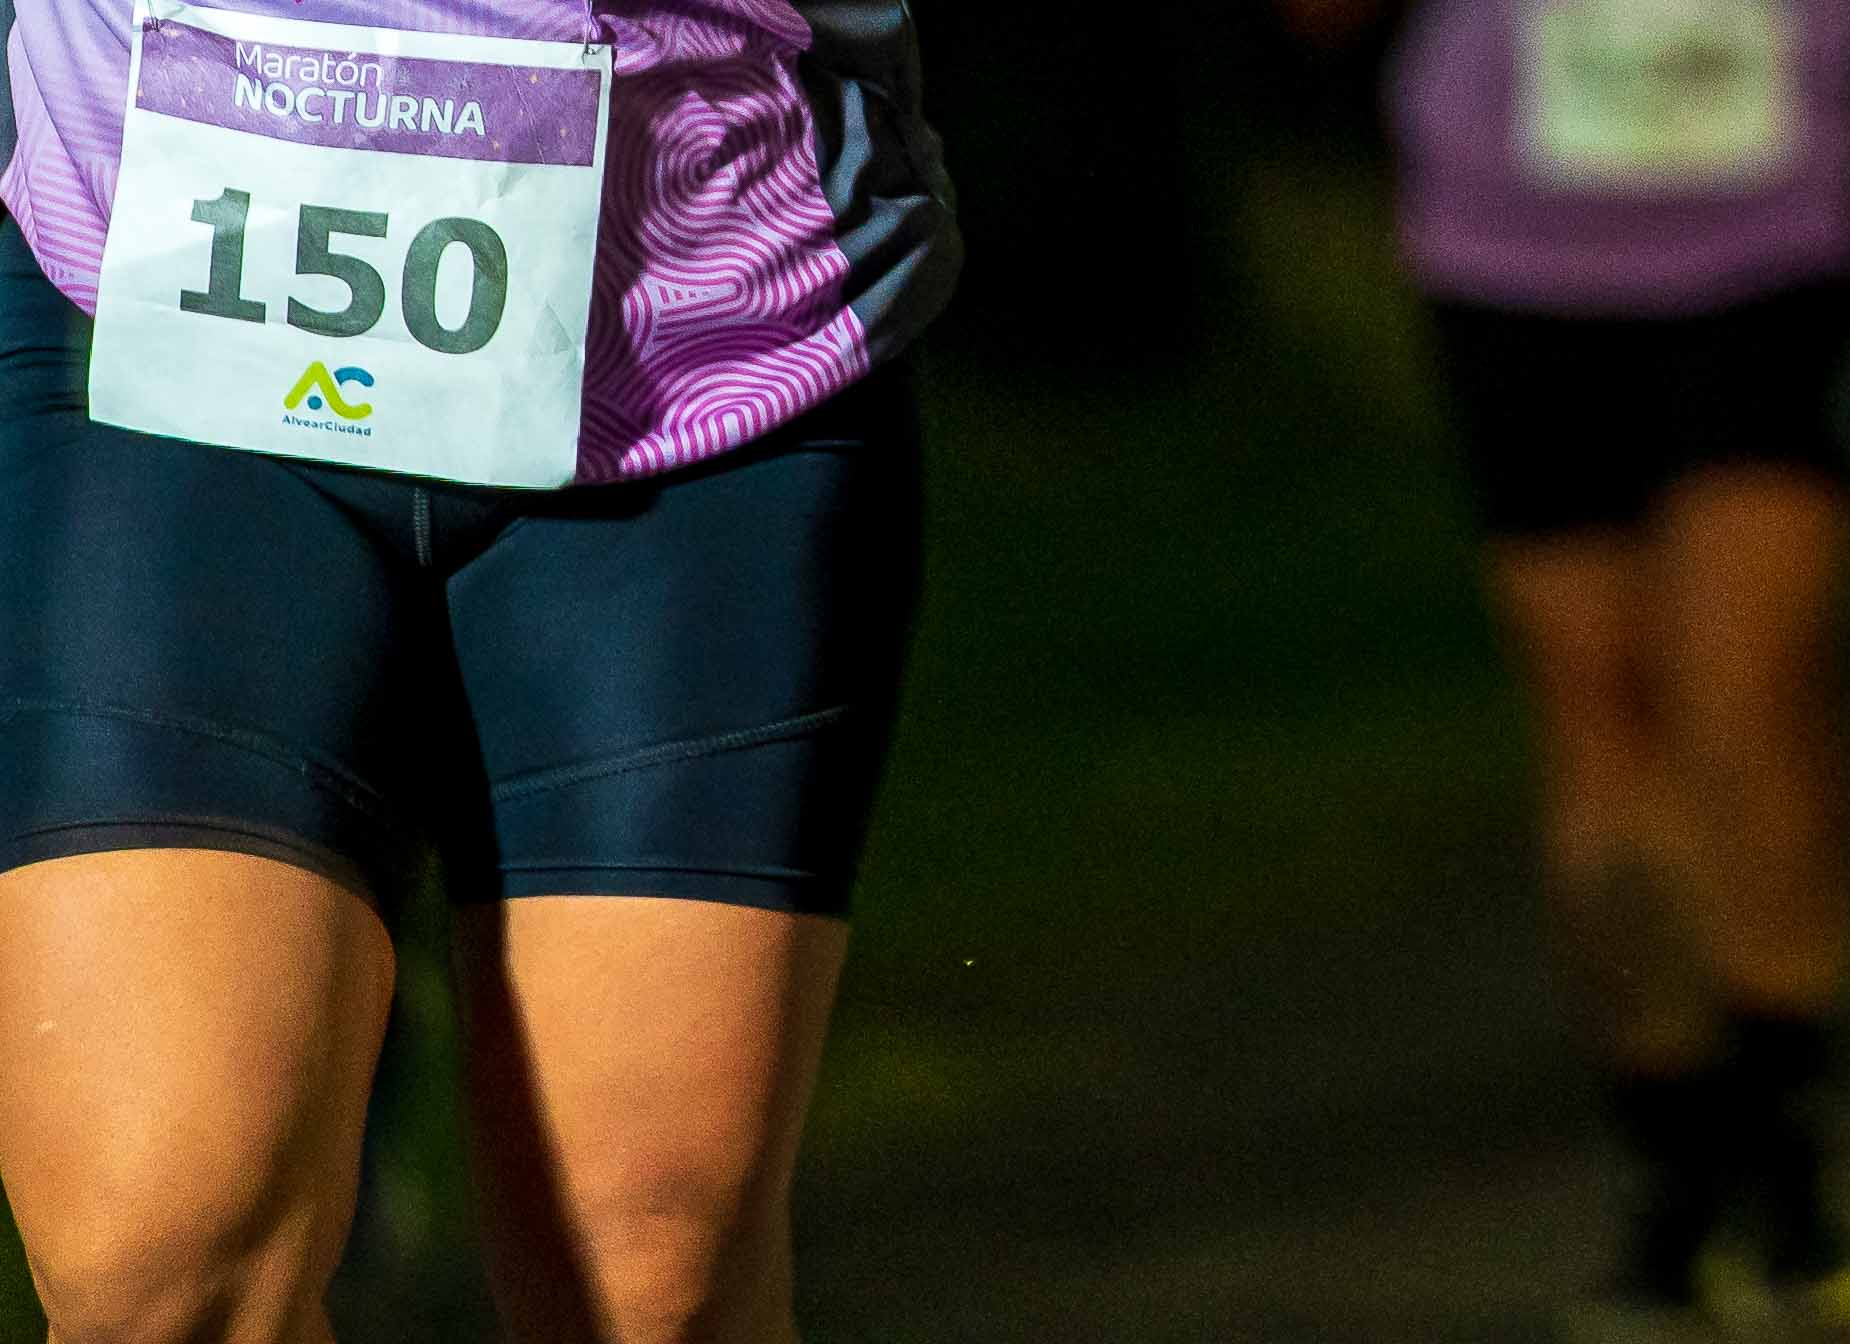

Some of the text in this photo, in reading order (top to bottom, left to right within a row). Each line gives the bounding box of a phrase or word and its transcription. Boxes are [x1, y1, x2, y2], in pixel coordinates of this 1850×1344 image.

[234, 40, 384, 89] Maratón
[233, 73, 487, 138] NOCTURNA
[179, 186, 509, 356] 150
[281, 414, 372, 437] AlvearCiudad
